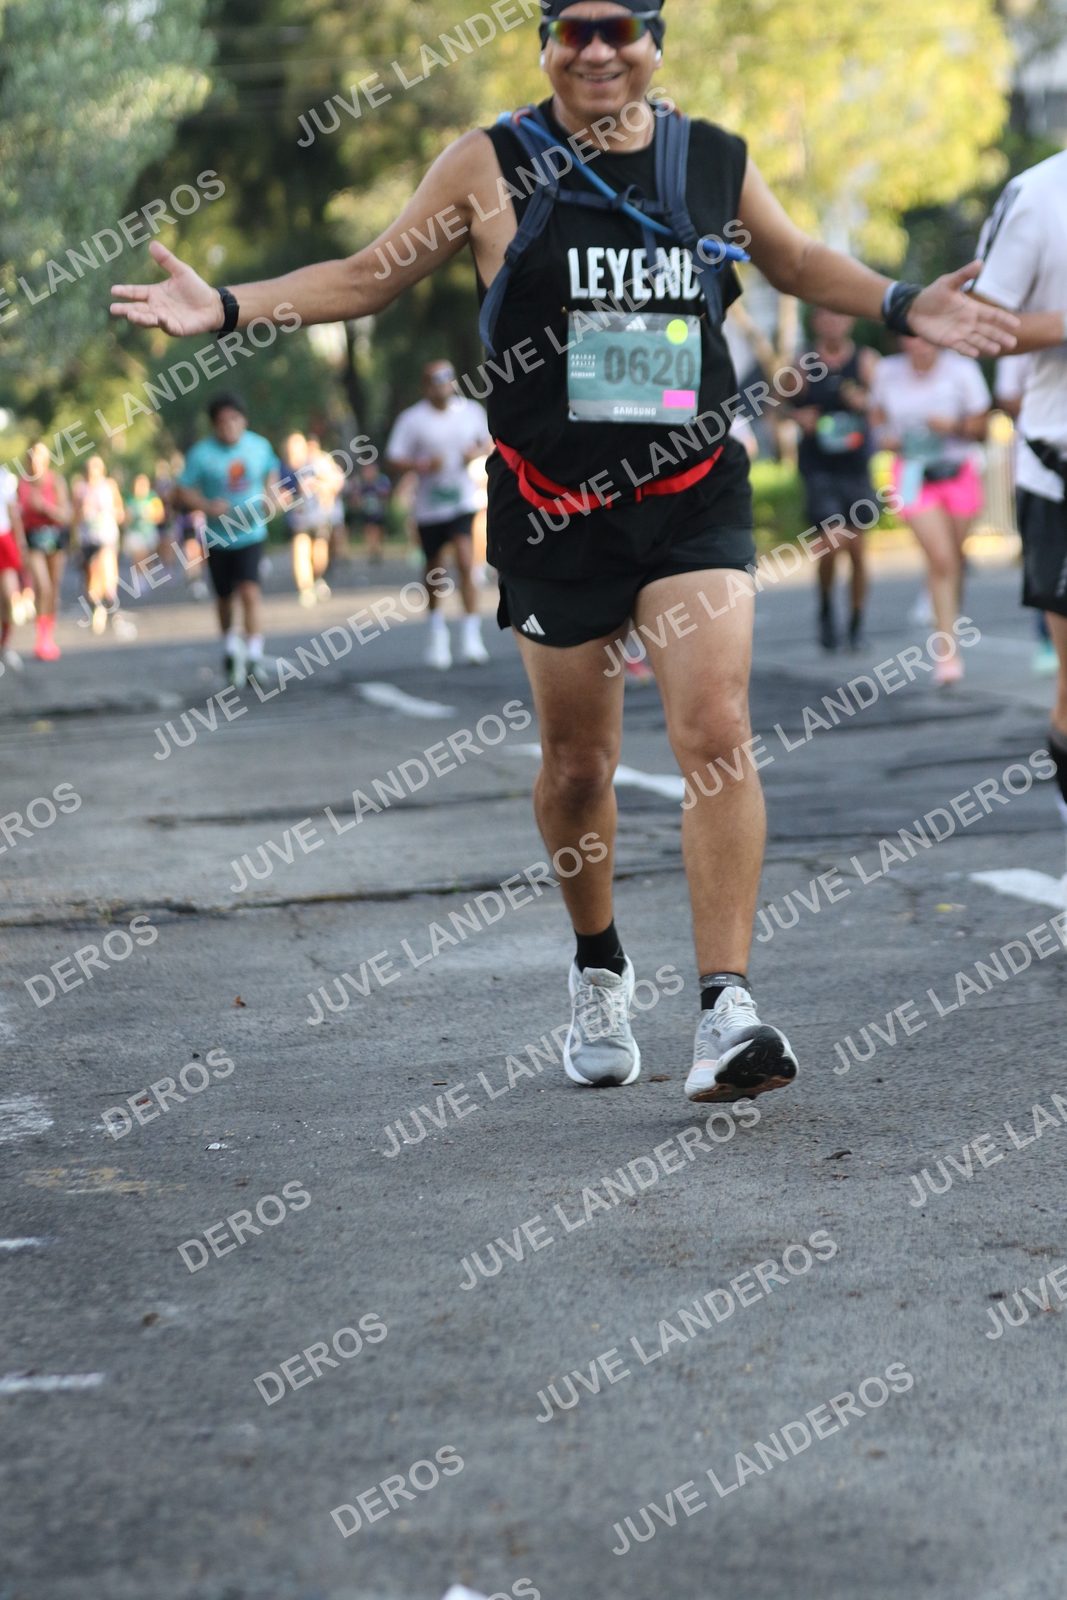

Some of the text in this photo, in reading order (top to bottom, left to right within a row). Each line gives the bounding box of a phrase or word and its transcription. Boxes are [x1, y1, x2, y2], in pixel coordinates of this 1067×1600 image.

[567, 247, 705, 300] LEYEND
[604, 346, 696, 388] 0620
[613, 406, 657, 416] SAMSUNG
